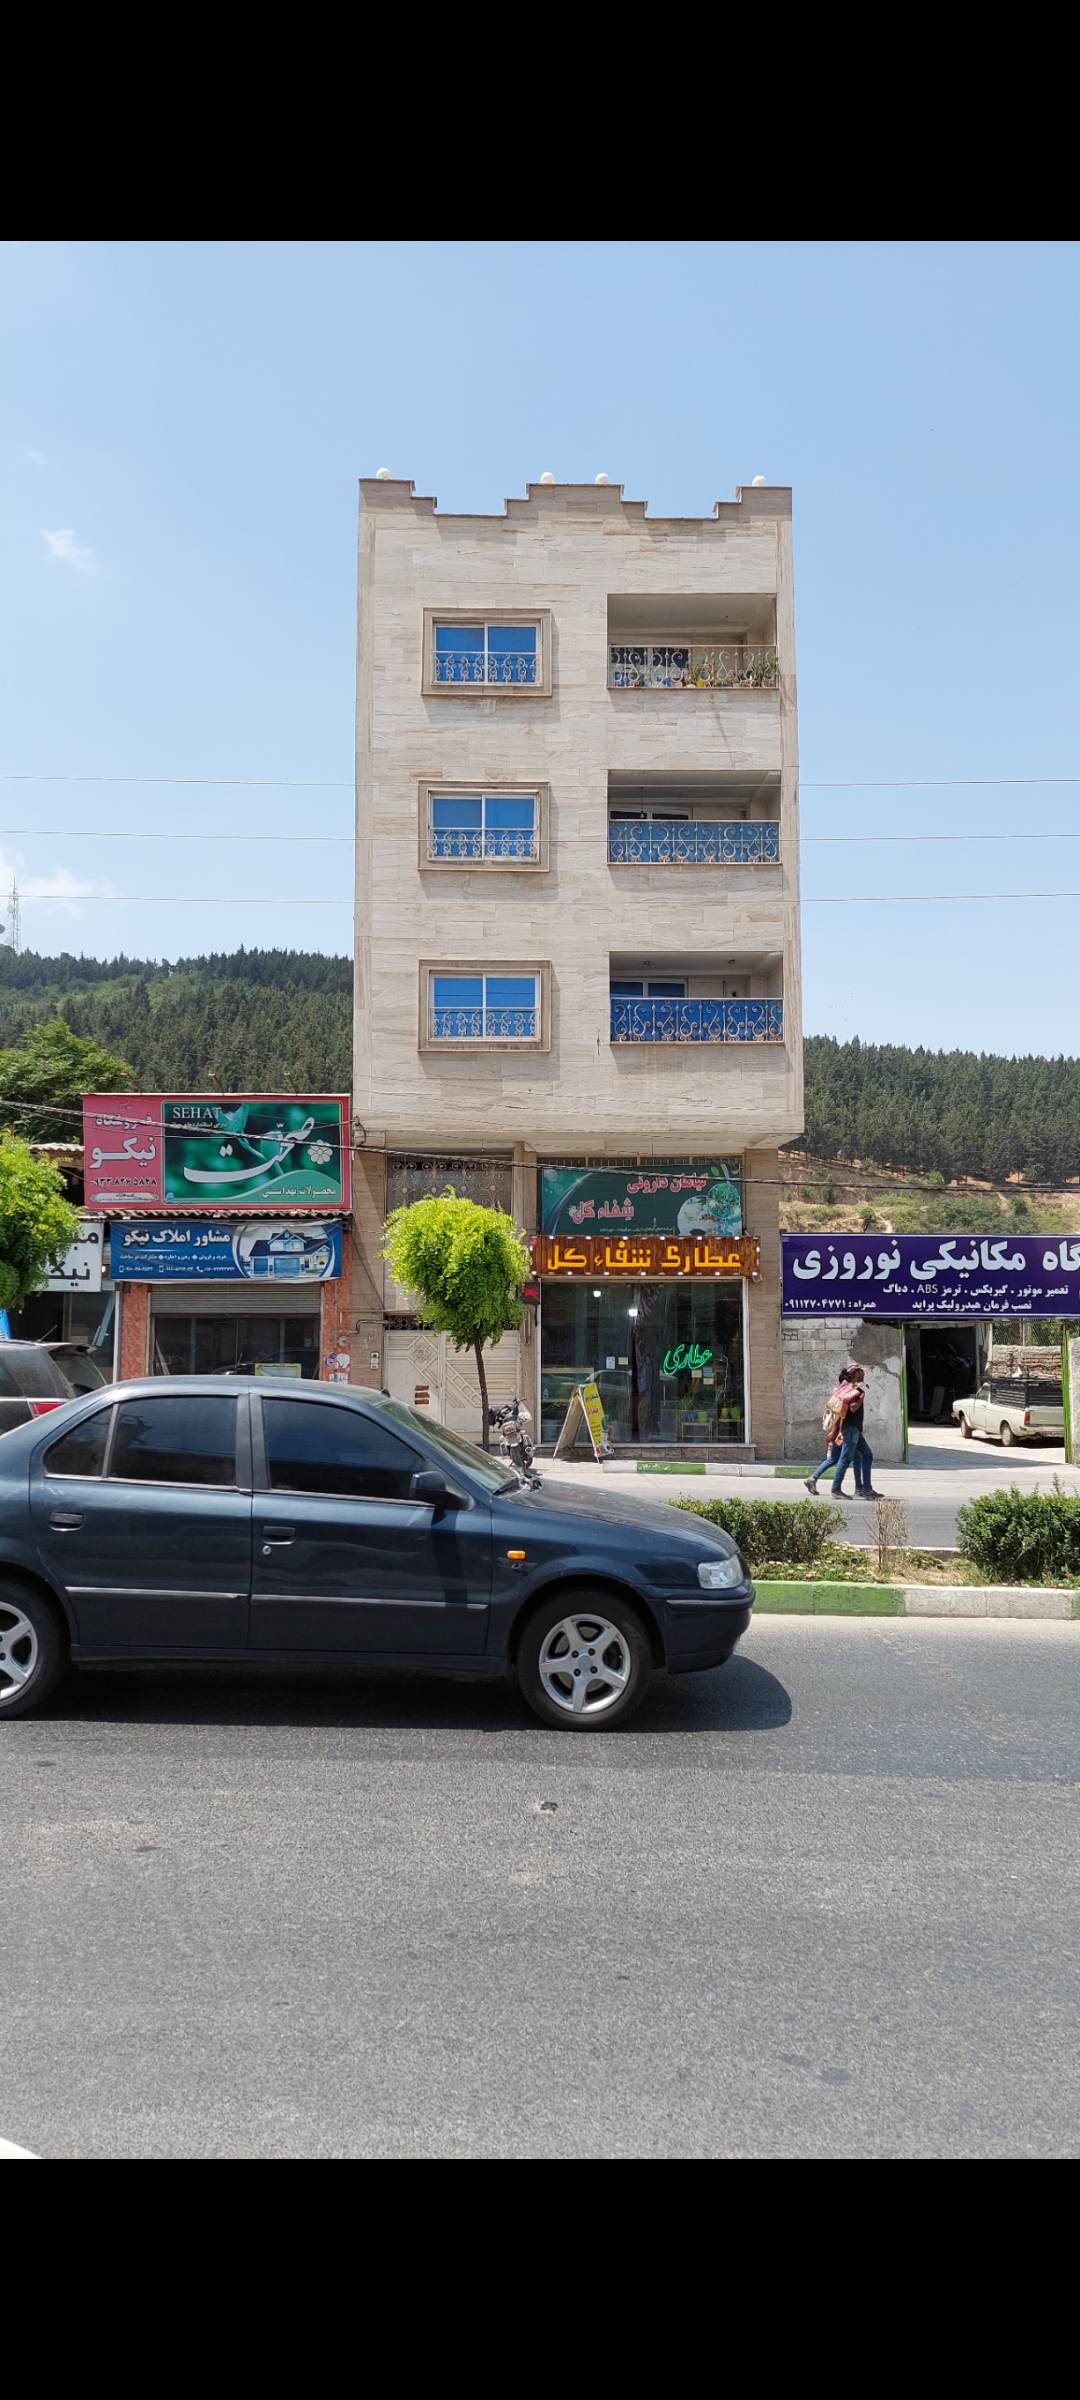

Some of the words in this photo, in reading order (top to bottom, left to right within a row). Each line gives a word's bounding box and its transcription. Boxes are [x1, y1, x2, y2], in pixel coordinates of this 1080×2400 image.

[172, 1106, 222, 1119] SEHAT
[89, 1138, 155, 1168] نیکو
[261, 1186, 297, 1198] بهداشتی
[299, 1187, 337, 1197] محصولات
[572, 1200, 594, 1224] گل
[122, 1229, 150, 1247] نیکو
[152, 1229, 191, 1244] املاک
[193, 1229, 231, 1247] مشاور
[548, 1246, 586, 1269] گل
[793, 1240, 900, 1279] نوروزی
[910, 1240, 1025, 1280] مکانیکی
[48, 1262, 89, 1286] نیک
[883, 1284, 908, 1296] دیاگ
[916, 1284, 938, 1294] ABS
[941, 1283, 962, 1297] ترمز
[970, 1283, 1008, 1297] گیربکس
[1017, 1284, 1043, 1297] موتور
[1045, 1284, 1069, 1297] تعمیر
[853, 1299, 877, 1311] همراه
[912, 1299, 935, 1312] پراید
[936, 1299, 981, 1311] هیدرولیک
[983, 1299, 1009, 1312] فرمان
[1011, 1299, 1032, 1311] نصب
[664, 1344, 712, 1376] عطاری
